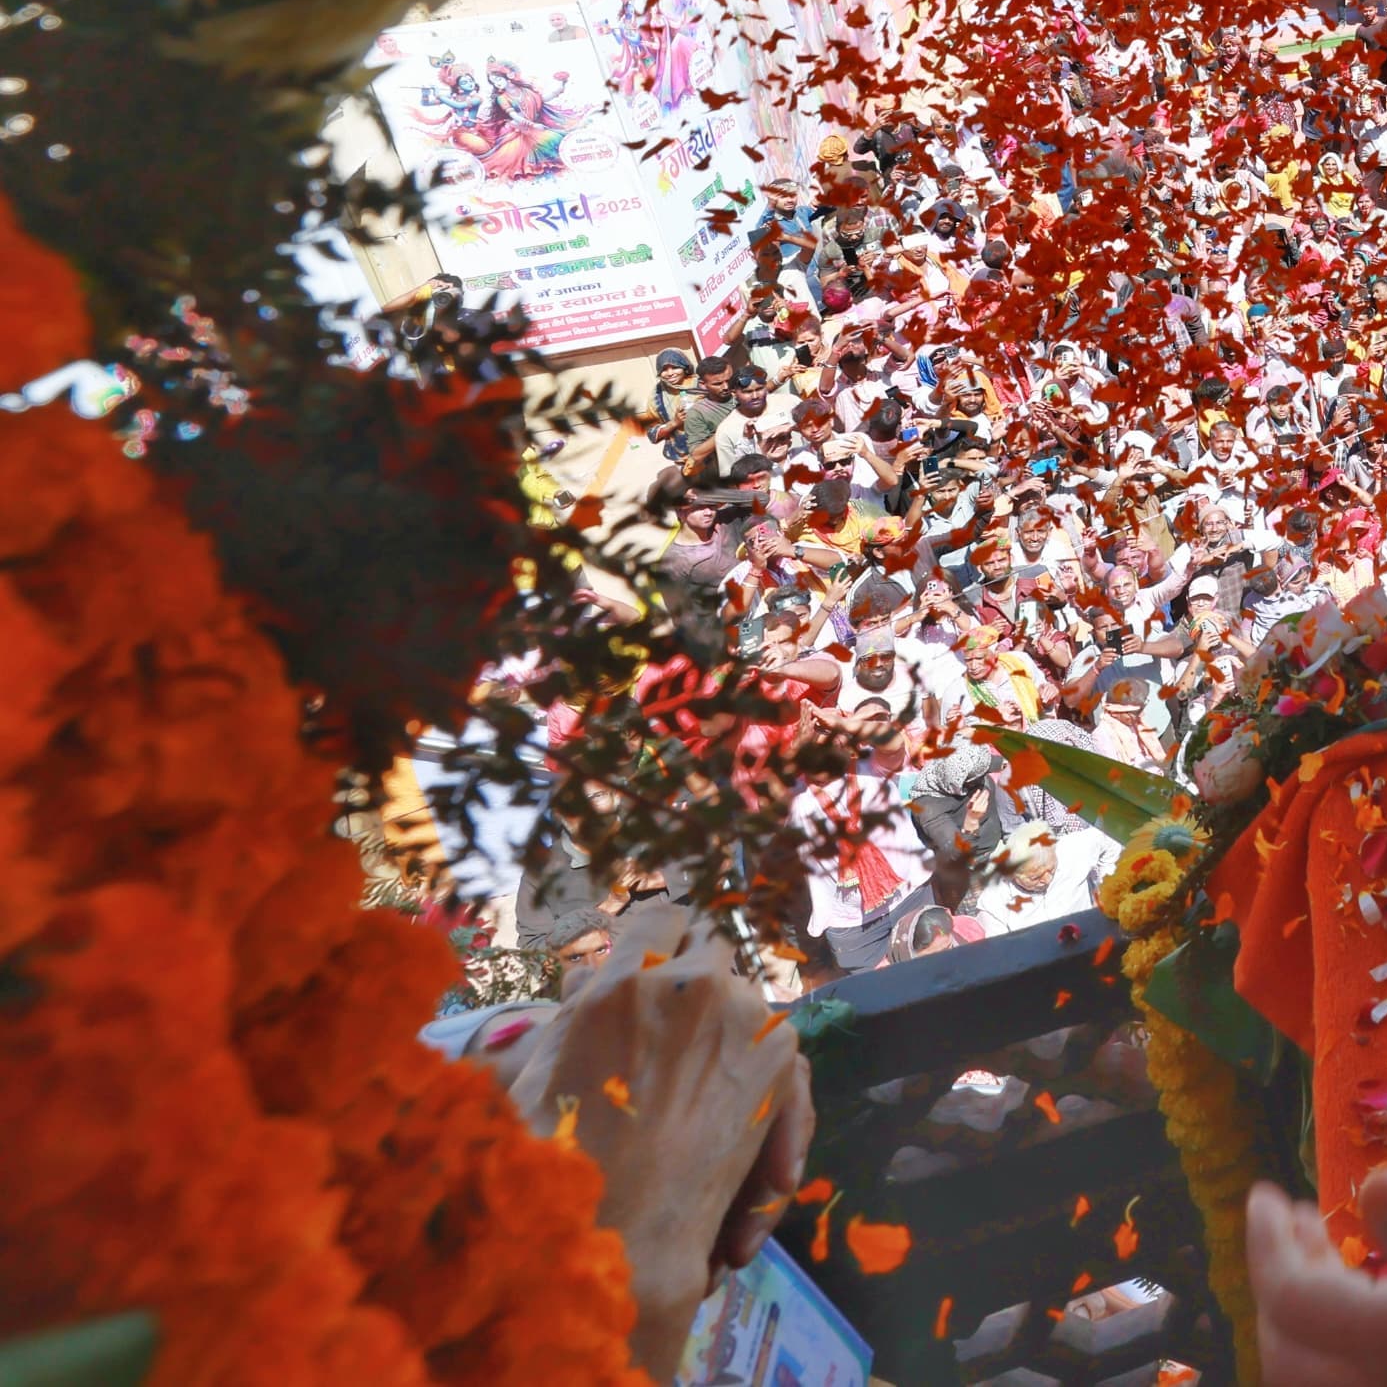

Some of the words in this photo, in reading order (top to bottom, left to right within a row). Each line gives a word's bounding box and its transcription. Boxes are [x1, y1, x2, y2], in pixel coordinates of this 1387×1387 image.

[715, 114, 736, 140] 2025
[596, 197, 643, 215] 2025
[561, 291, 628, 310] स्वागत
